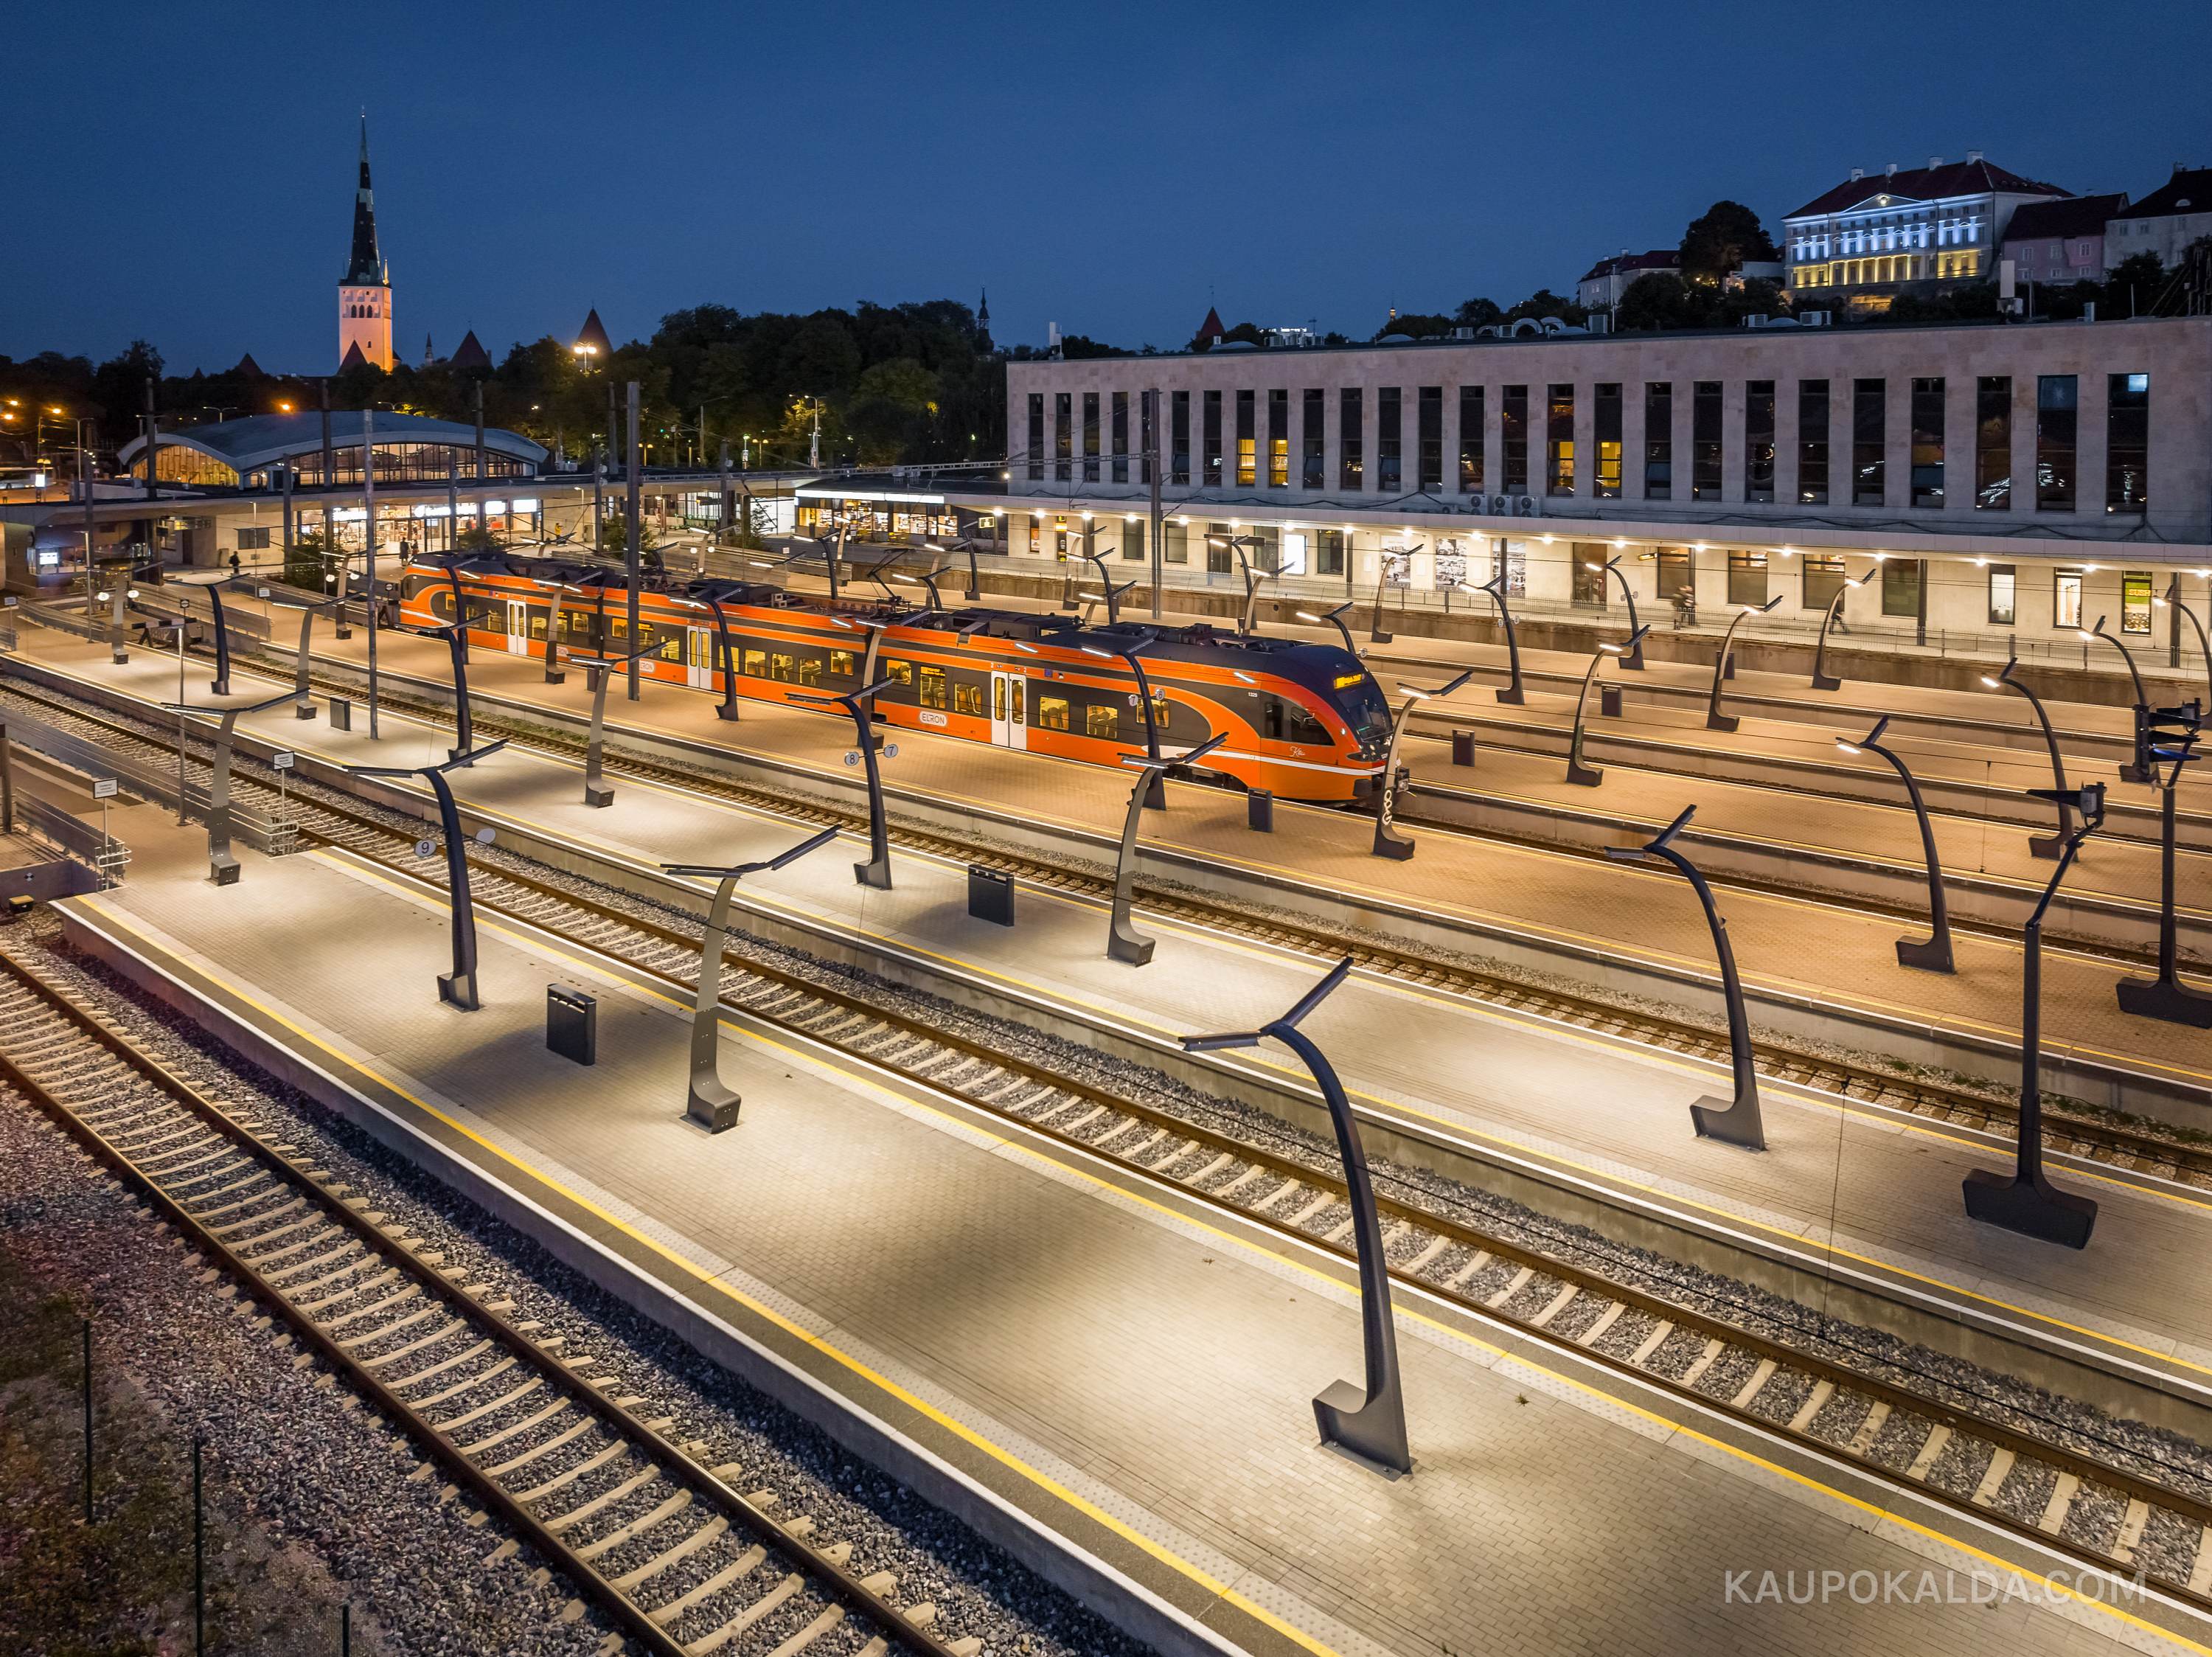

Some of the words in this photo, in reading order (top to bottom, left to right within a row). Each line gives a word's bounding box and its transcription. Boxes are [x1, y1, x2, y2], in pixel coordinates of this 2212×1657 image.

[922, 713, 945, 724] ELRON
[888, 746, 894, 756] 7
[849, 754, 855, 765] 8
[421, 841, 430, 854] 9
